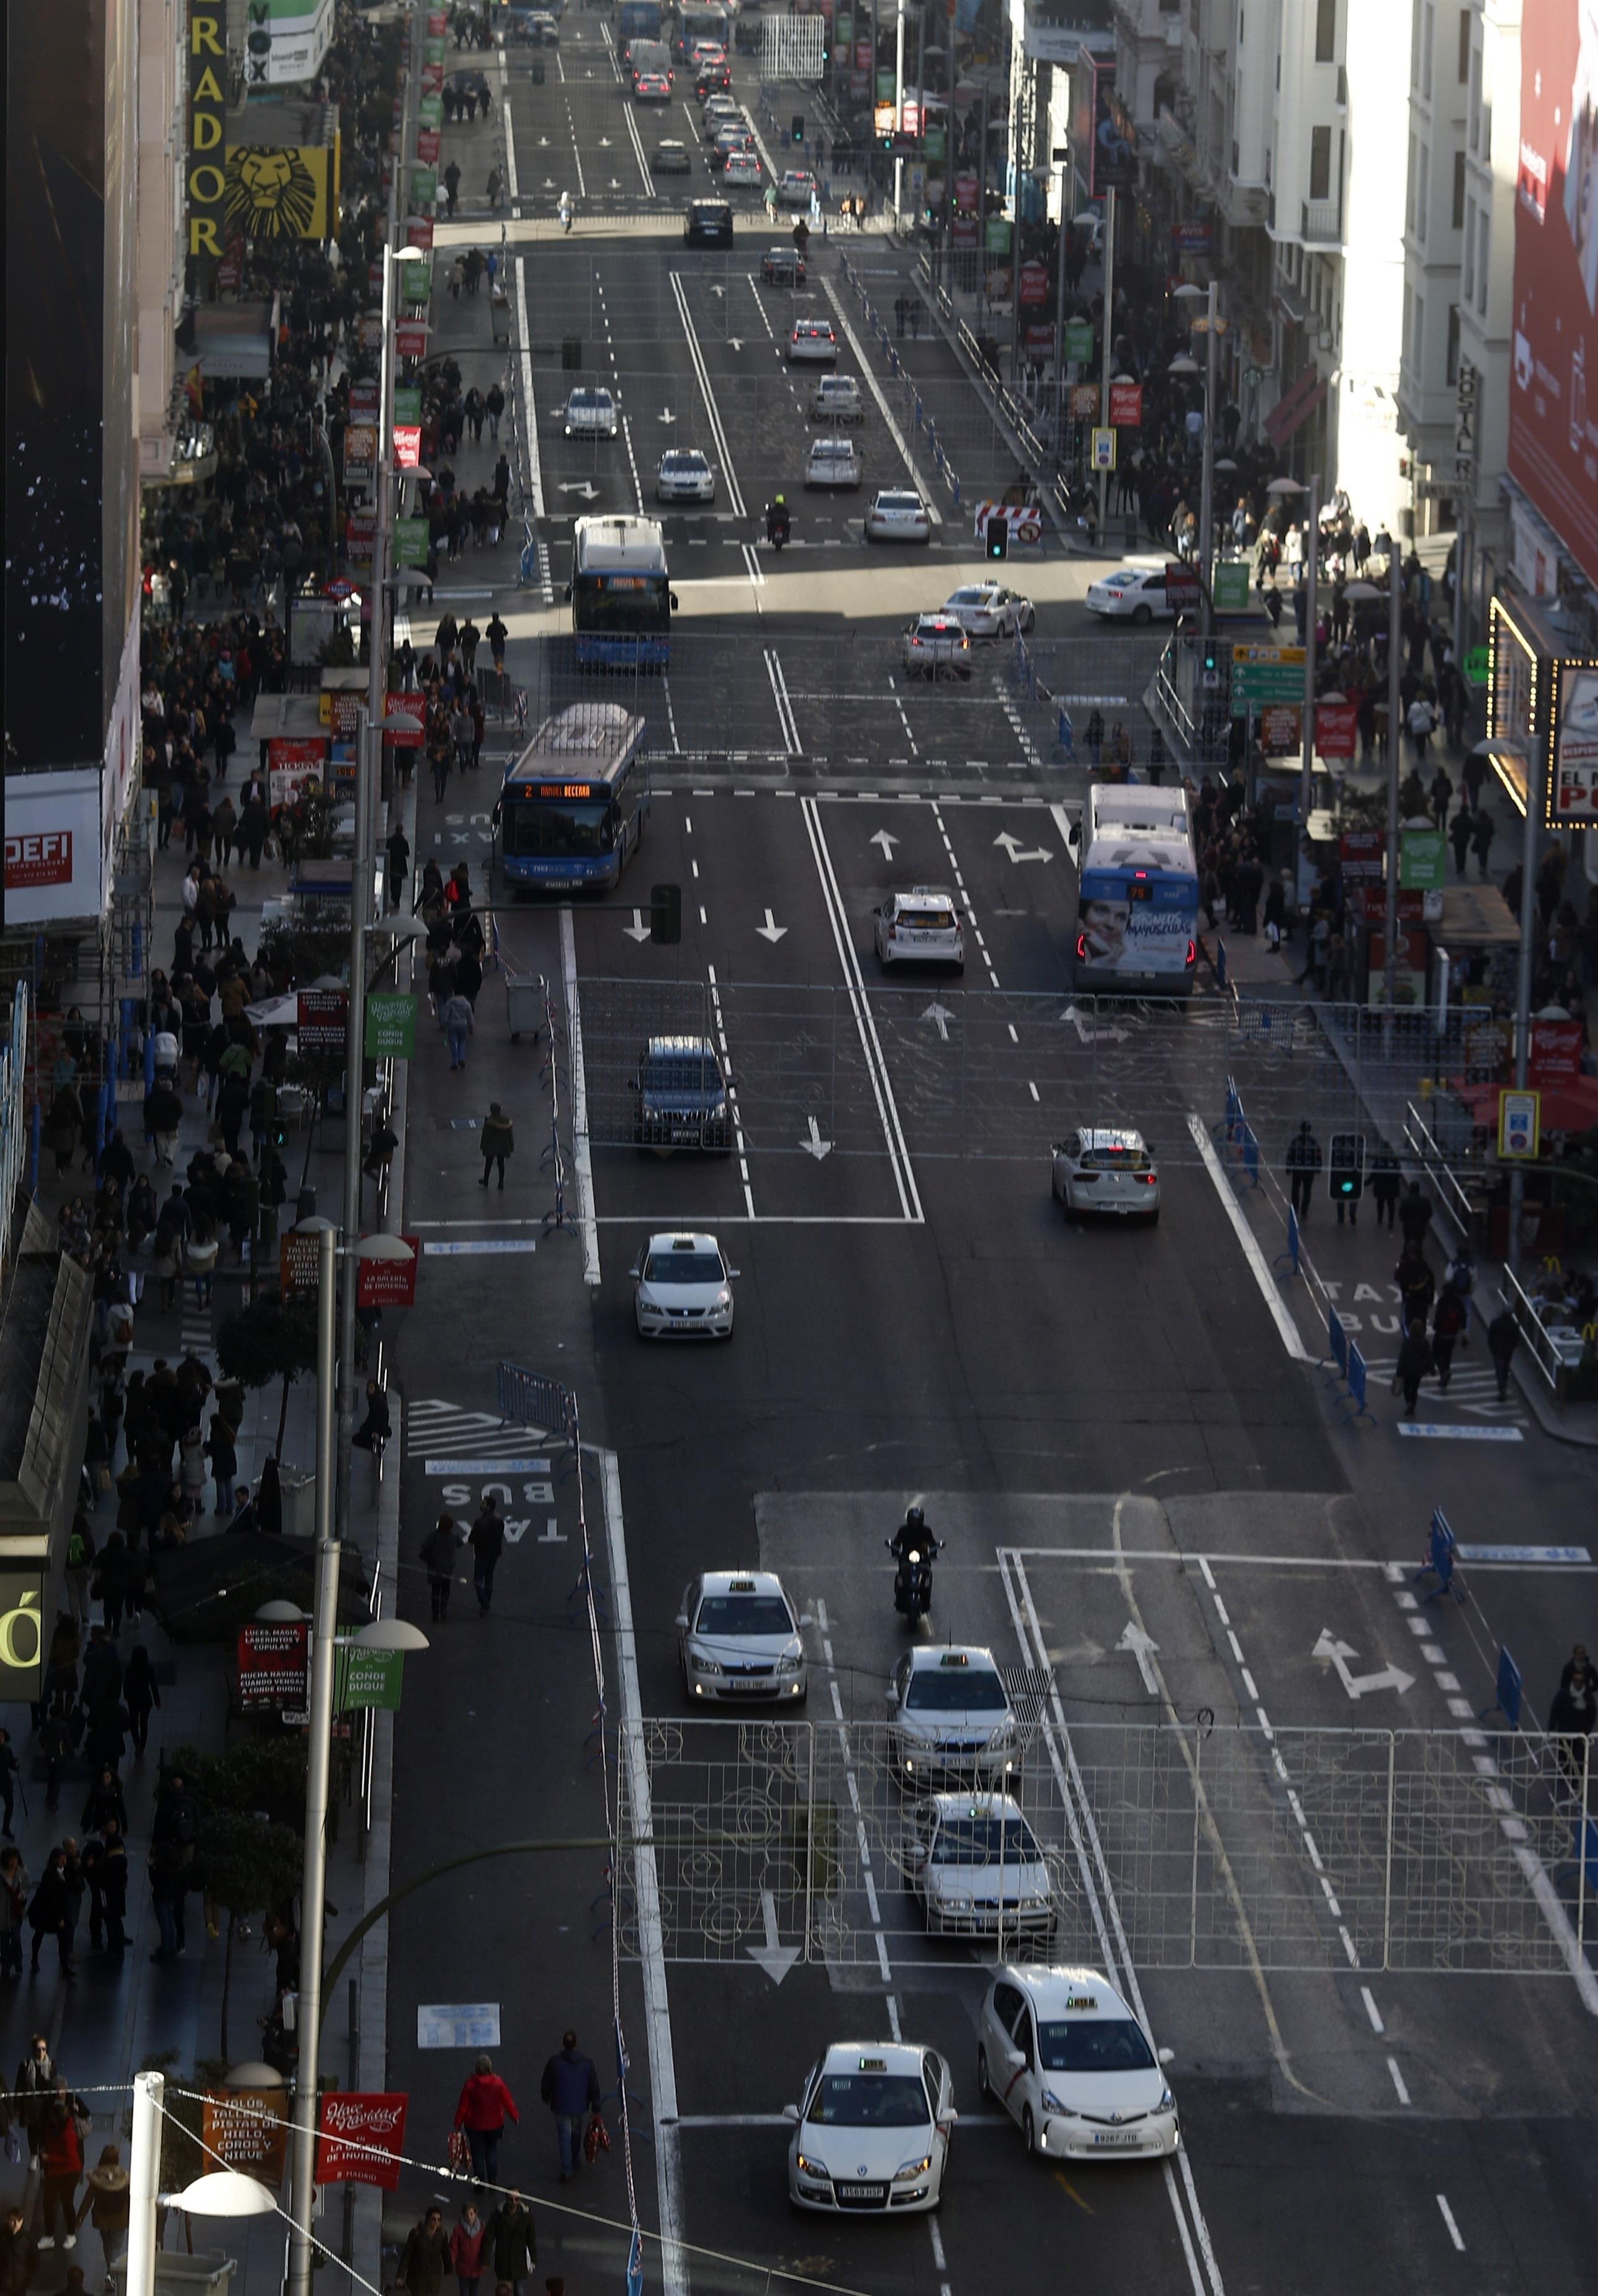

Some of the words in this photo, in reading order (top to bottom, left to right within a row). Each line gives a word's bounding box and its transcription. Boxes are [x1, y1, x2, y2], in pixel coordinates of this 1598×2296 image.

[189, 0, 225, 257] RADOR
[1180, 227, 1204, 236] AVIS
[1458, 367, 1475, 453] HOSTAL
[331, 585, 350, 594] Metro
[524, 784, 532, 798] 2
[378, 1031, 403, 1039] CONDE
[377, 1038, 403, 1046] DUQUE
[295, 1278, 319, 1286] NIEV
[375, 1283, 409, 1291] INVIERNO
[442, 1482, 555, 1506] BUS
[349, 1672, 386, 1680] CONDE
[240, 1679, 272, 1687] CUANDO
[349, 1683, 385, 1692] DUQUE
[326, 2102, 364, 2126] Hace
[337, 2105, 402, 2133] Navidad
[212, 2120, 258, 2130] PISTAS
[263, 2120, 278, 2130] DE
[224, 2130, 266, 2140] HIELO,
[217, 2141, 259, 2150] COROS
[263, 2141, 272, 2150] Y
[330, 2144, 344, 2153] LA
[225, 2151, 263, 2161] NIEVE
[327, 2155, 339, 2163] DE
[342, 2153, 392, 2165] INVIERNO
[346, 2171, 377, 2181] MADRID
